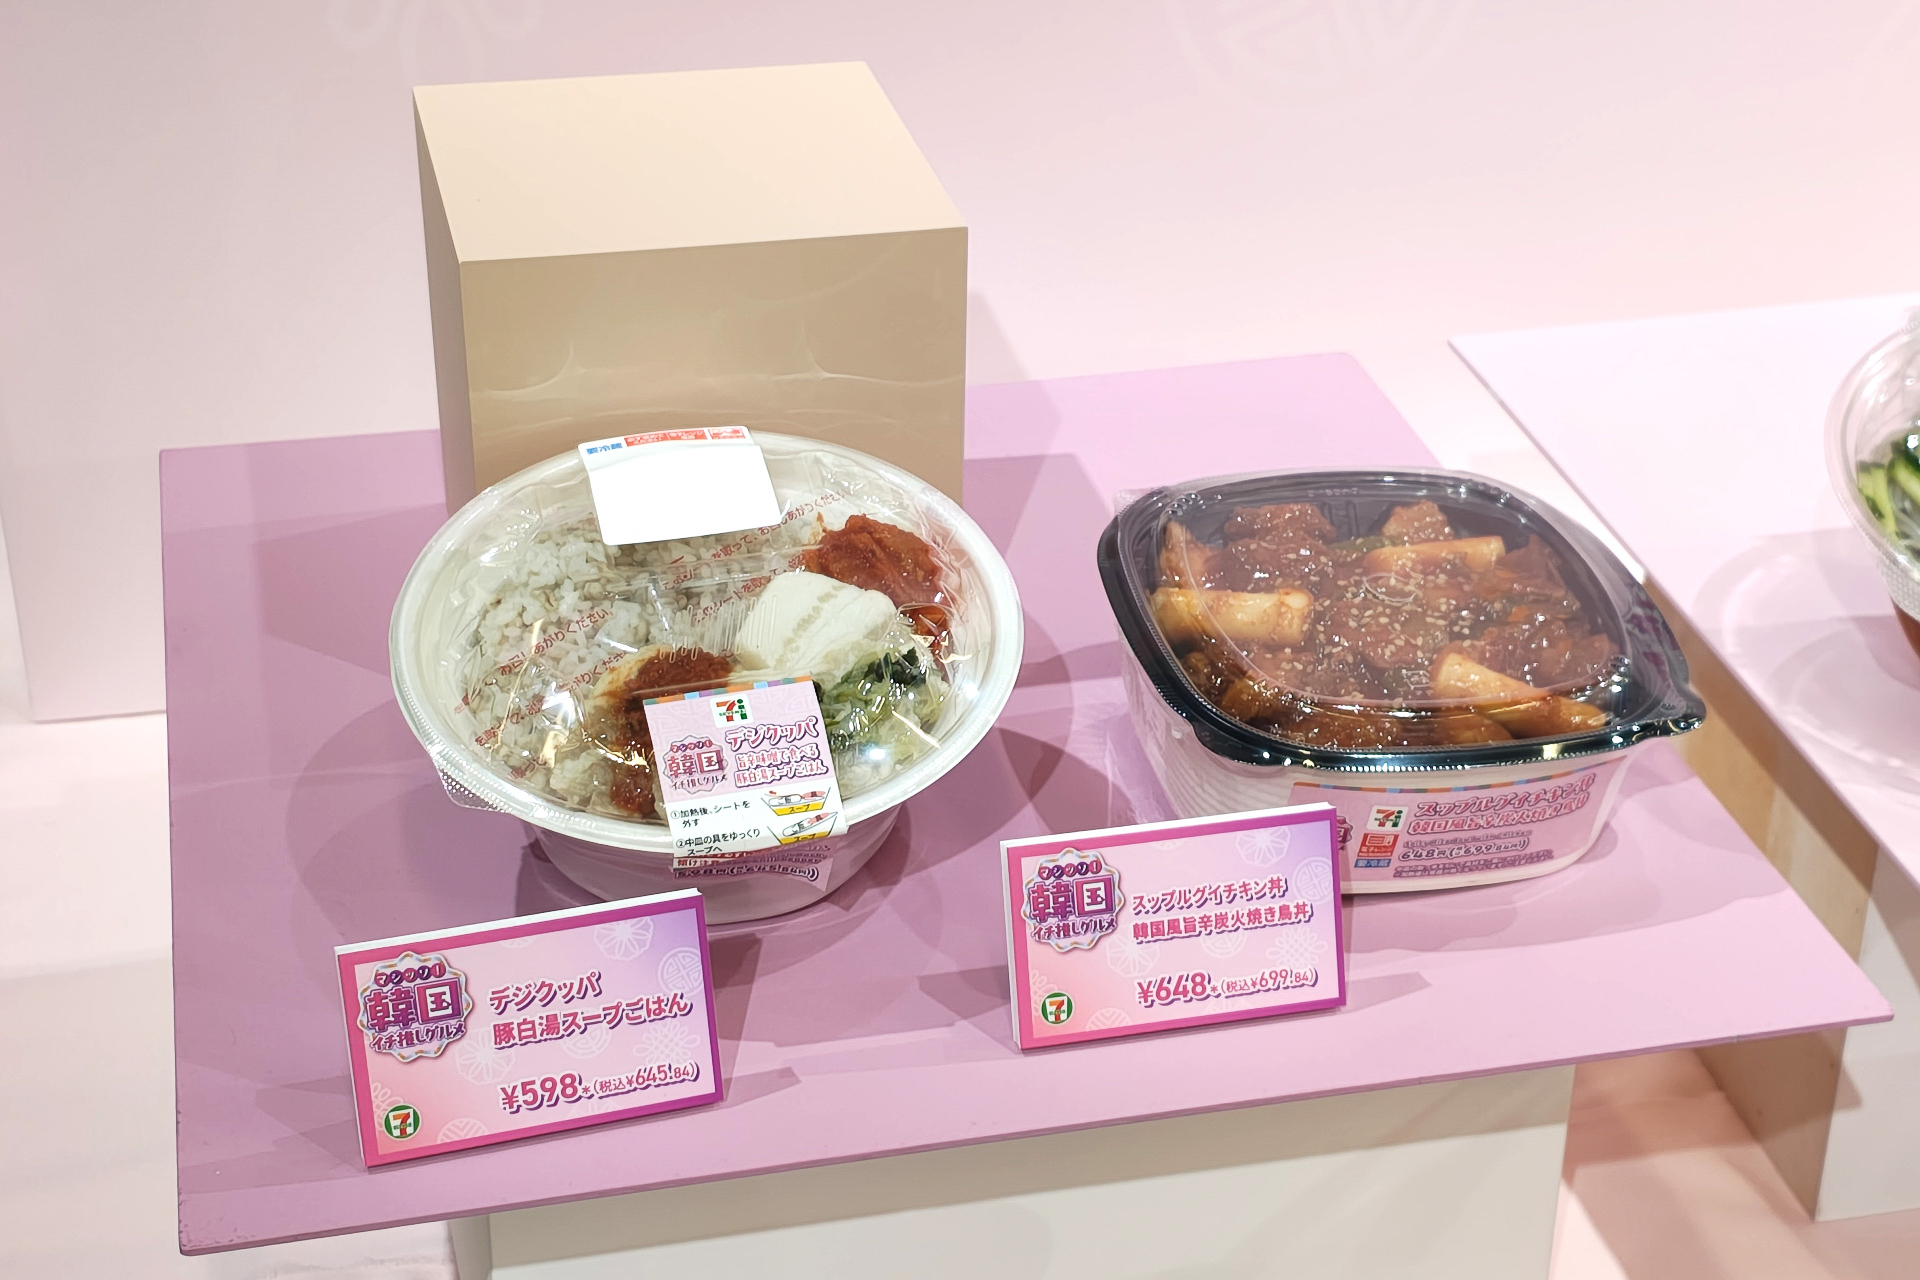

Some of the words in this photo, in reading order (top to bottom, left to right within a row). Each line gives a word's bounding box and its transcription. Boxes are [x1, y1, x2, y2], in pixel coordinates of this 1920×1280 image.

[586, 442, 623, 455] 要冷蔵
[726, 716, 819, 751] デジクッパ
[668, 750, 724, 778] 韓国
[735, 760, 828, 787] 豚白湯スープごはん
[683, 819, 699, 828] 外す
[688, 846, 722, 856] スープへ
[1030, 875, 1115, 922] 韓国
[1133, 876, 1287, 914] スップルグイチキン丼
[1032, 918, 1116, 940] イチ推しグルメ
[1133, 902, 1313, 942] 韓国風旨辛炭火焼き鳥丼
[366, 978, 462, 1032] 韓国
[490, 971, 600, 1013] デジクッパ
[493, 993, 691, 1047] 豚白湯スープごはん
[372, 1023, 465, 1050] イチ推しグルメ
